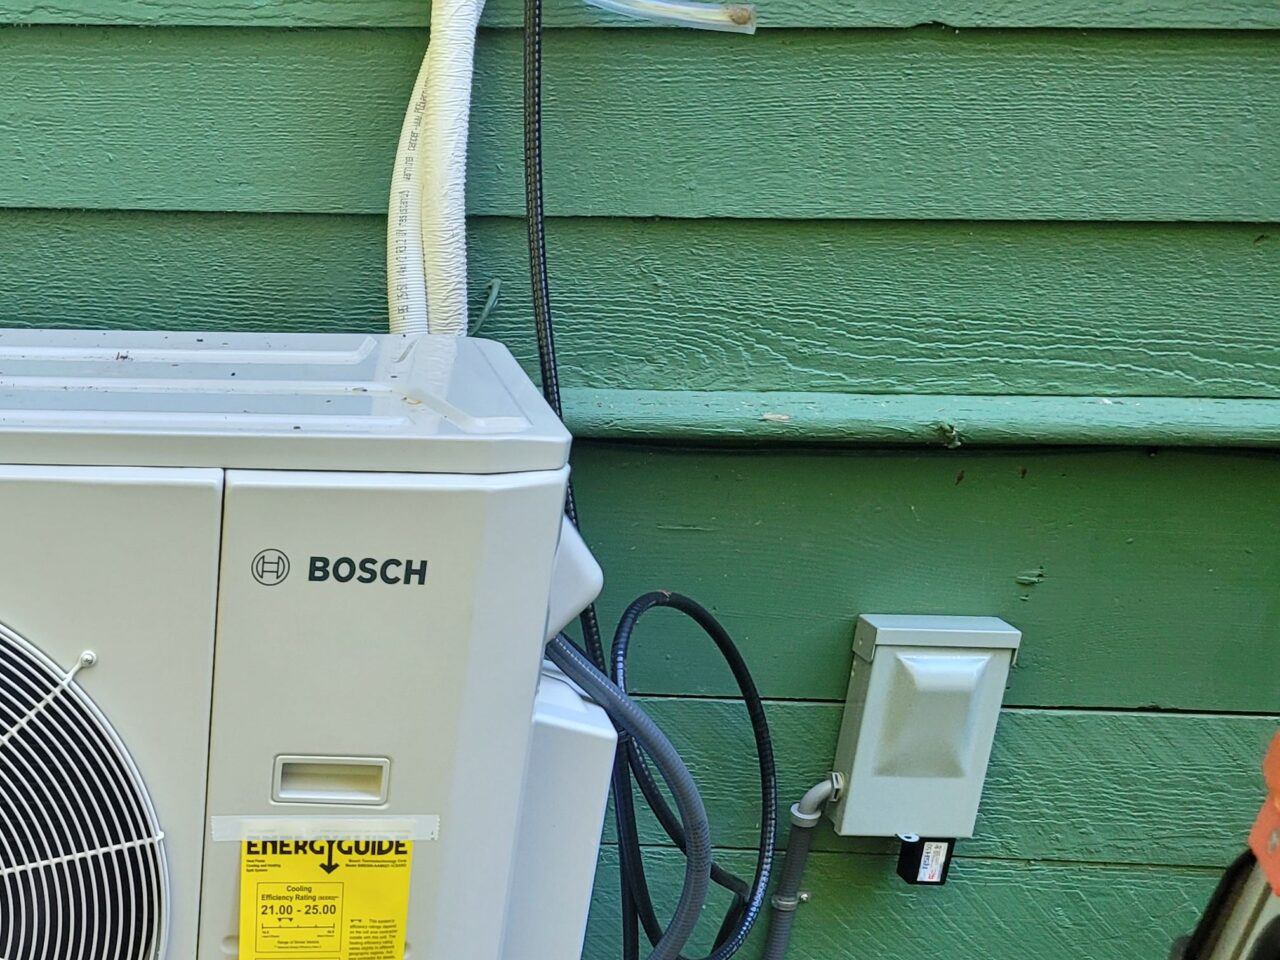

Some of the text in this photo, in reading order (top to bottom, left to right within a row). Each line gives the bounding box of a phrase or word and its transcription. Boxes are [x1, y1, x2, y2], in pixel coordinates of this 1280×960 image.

[308, 556, 428, 585] BOSCH
[286, 885, 312, 893] Cooling
[261, 894, 293, 902] Efficiency
[295, 894, 317, 902] Rating
[261, 904, 293, 915] 21.00
[304, 904, 337, 915] 25.00
